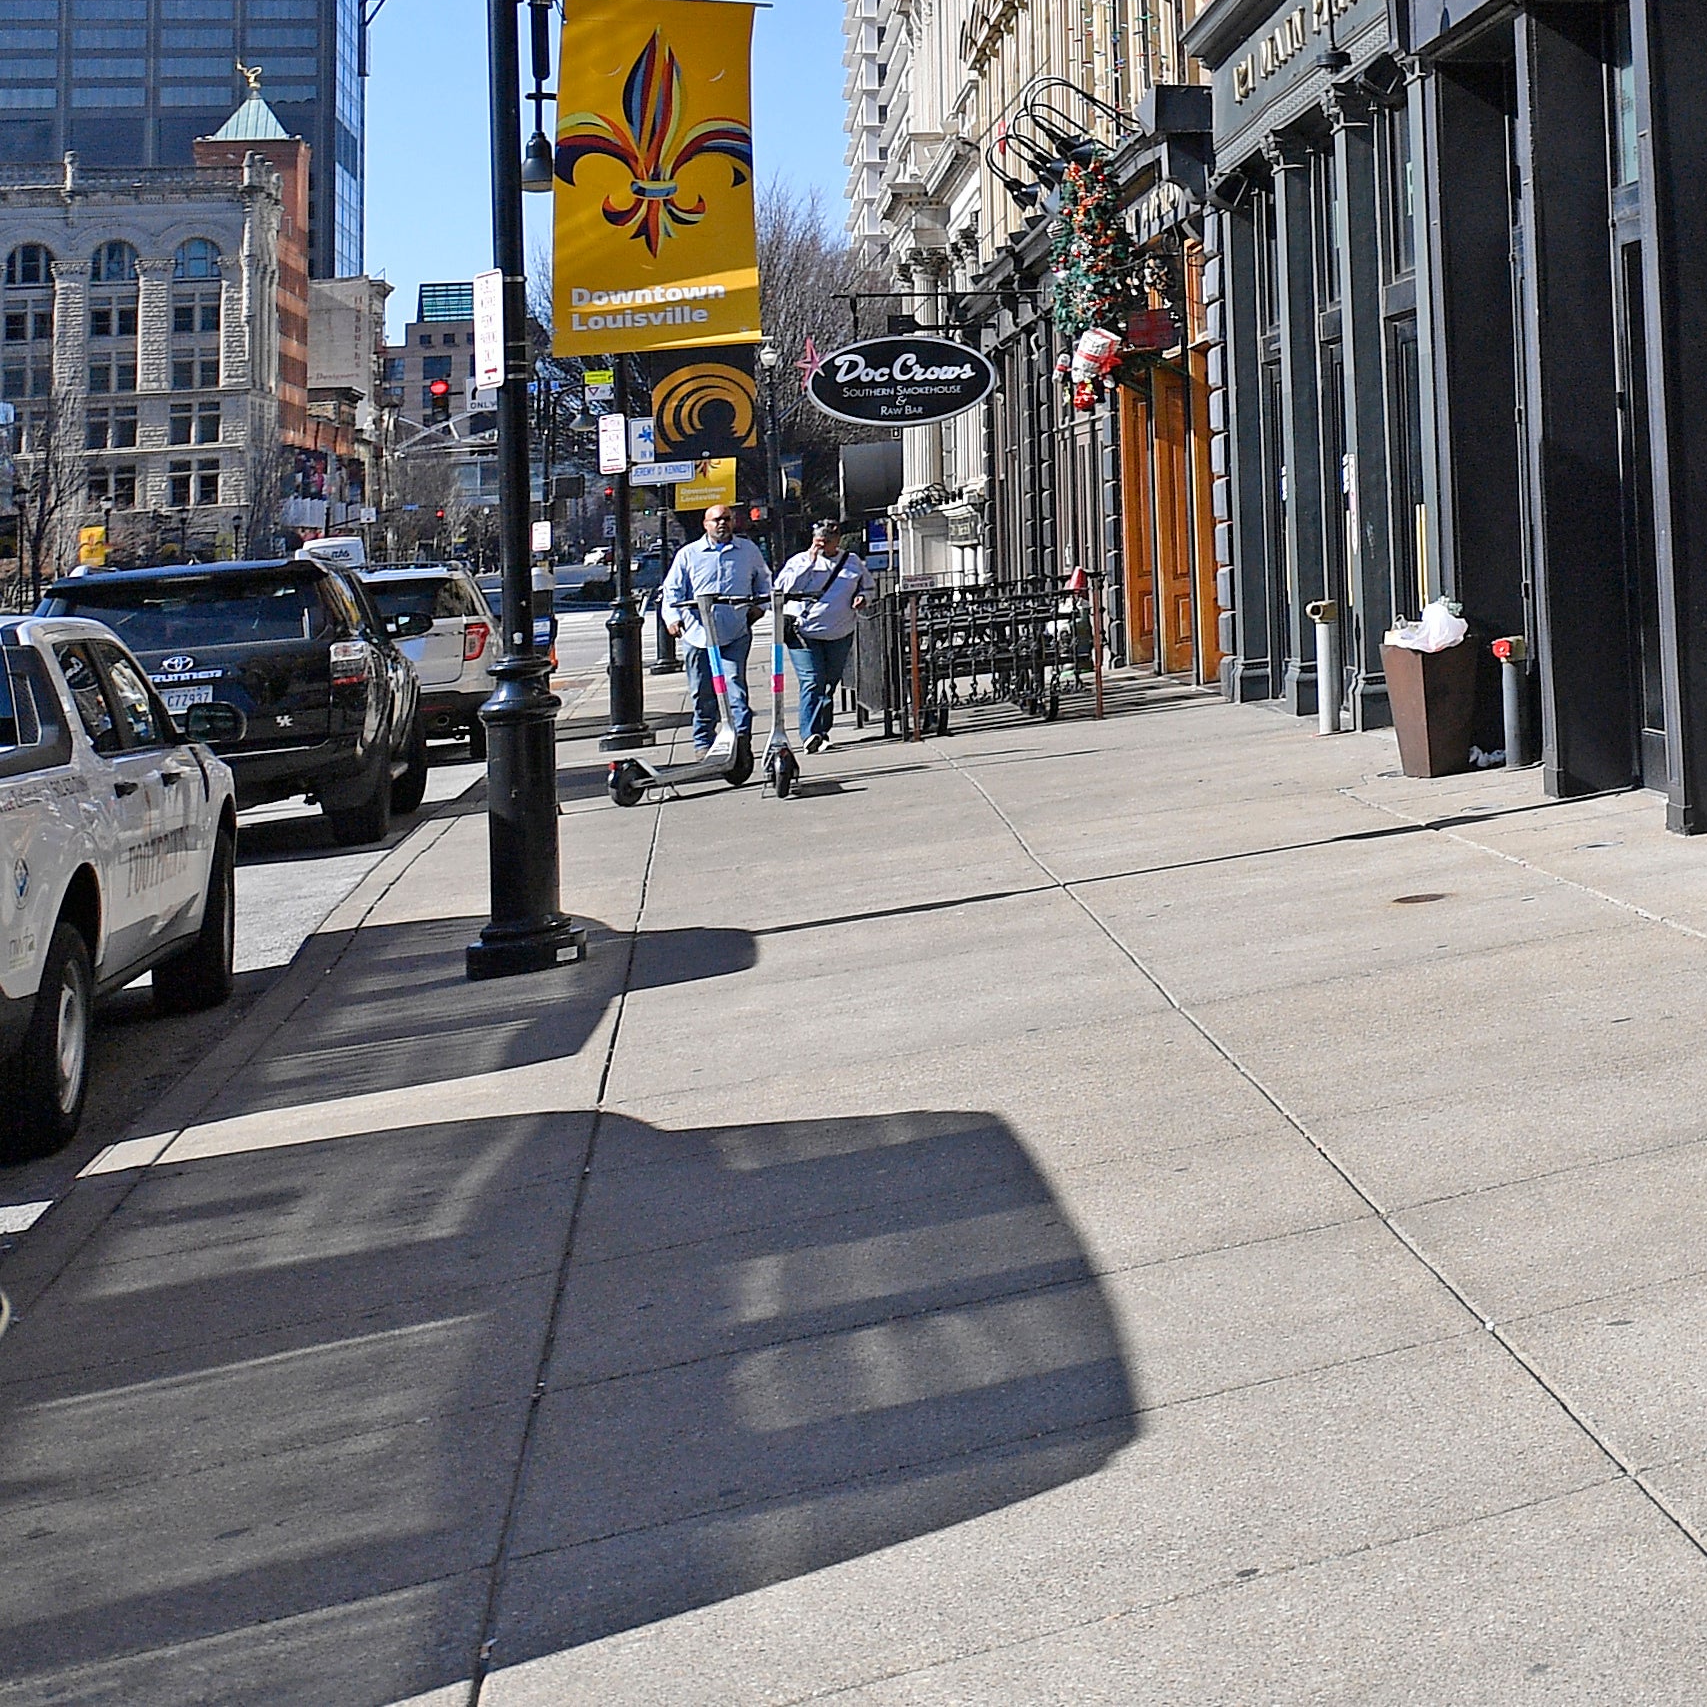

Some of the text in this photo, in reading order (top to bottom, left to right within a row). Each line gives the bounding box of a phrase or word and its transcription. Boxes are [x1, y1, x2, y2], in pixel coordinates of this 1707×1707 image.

[571, 284, 726, 307] Downtown
[572, 305, 708, 331] Louisville
[834, 354, 890, 383] Doc
[842, 384, 961, 398] SOUTHERN SMOKEHOUSE
[470, 400, 497, 410] ONLY
[896, 396, 907, 406] &
[881, 404, 923, 417] RAW BAR
[680, 485, 726, 495] Downtown
[680, 493, 721, 503] Louisville
